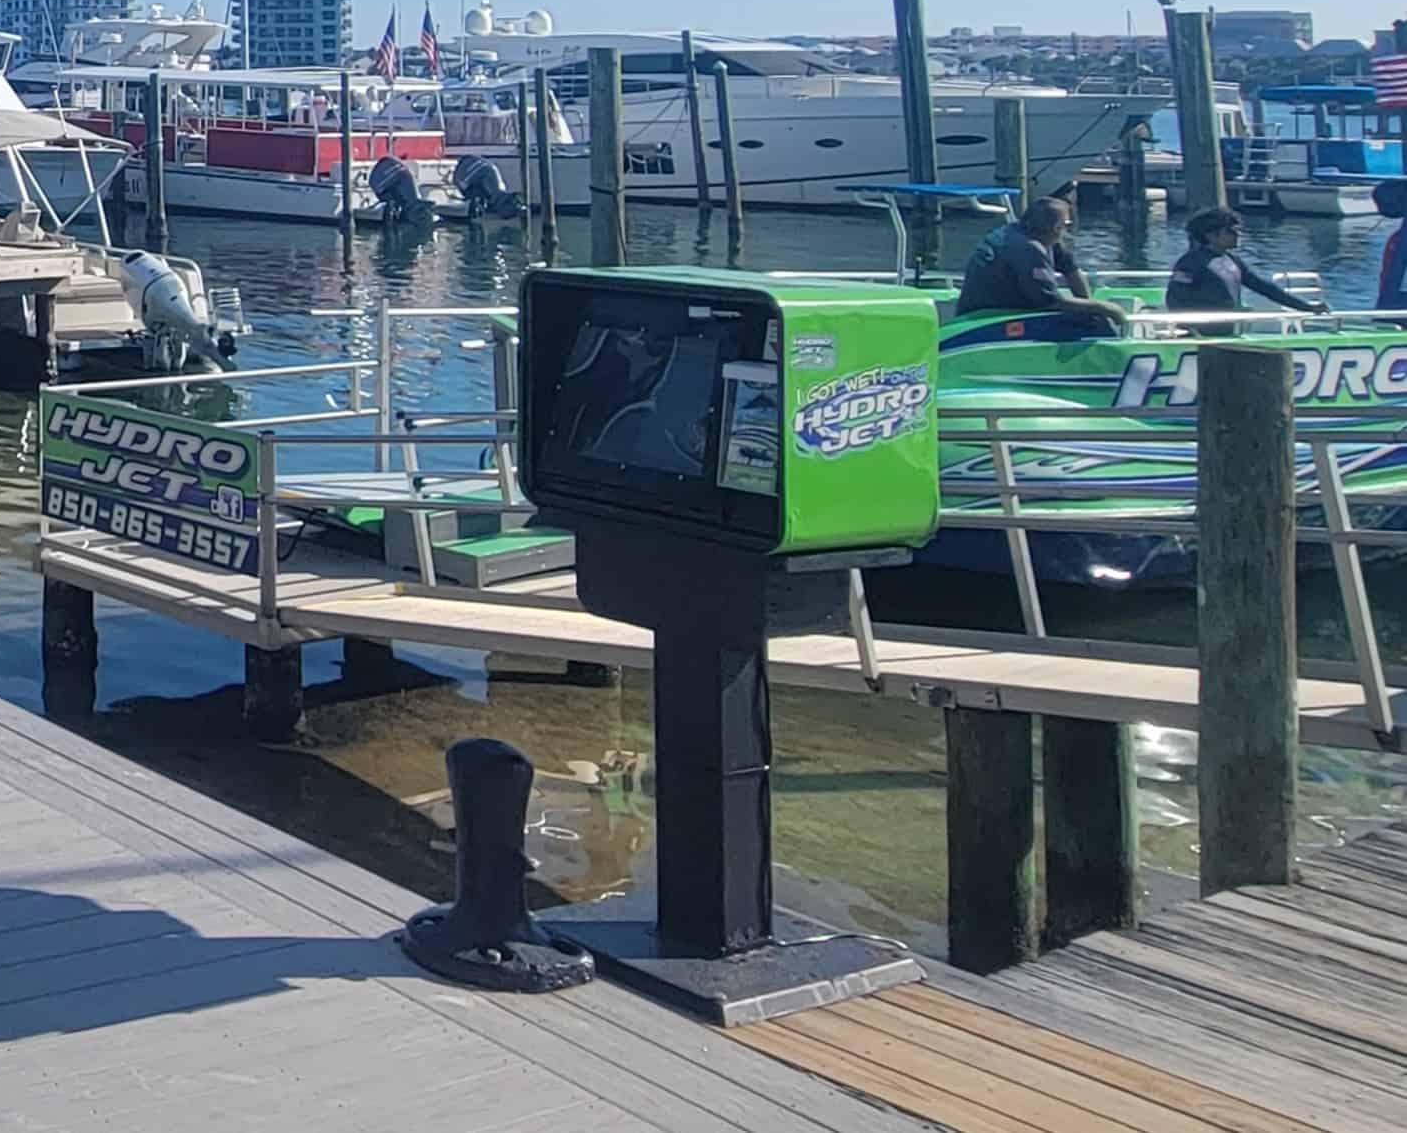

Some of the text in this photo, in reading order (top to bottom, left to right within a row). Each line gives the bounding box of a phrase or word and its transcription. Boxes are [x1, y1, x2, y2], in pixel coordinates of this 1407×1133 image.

[806, 379, 840, 404] GOT
[845, 366, 885, 391] WET!
[1113, 345, 1407, 407] HDRO
[793, 383, 929, 432] HYDRO
[47, 403, 248, 474] HYDRO
[820, 416, 900, 452] JET
[80, 455, 200, 502] JET
[47, 486, 250, 569] 850-865-3557
